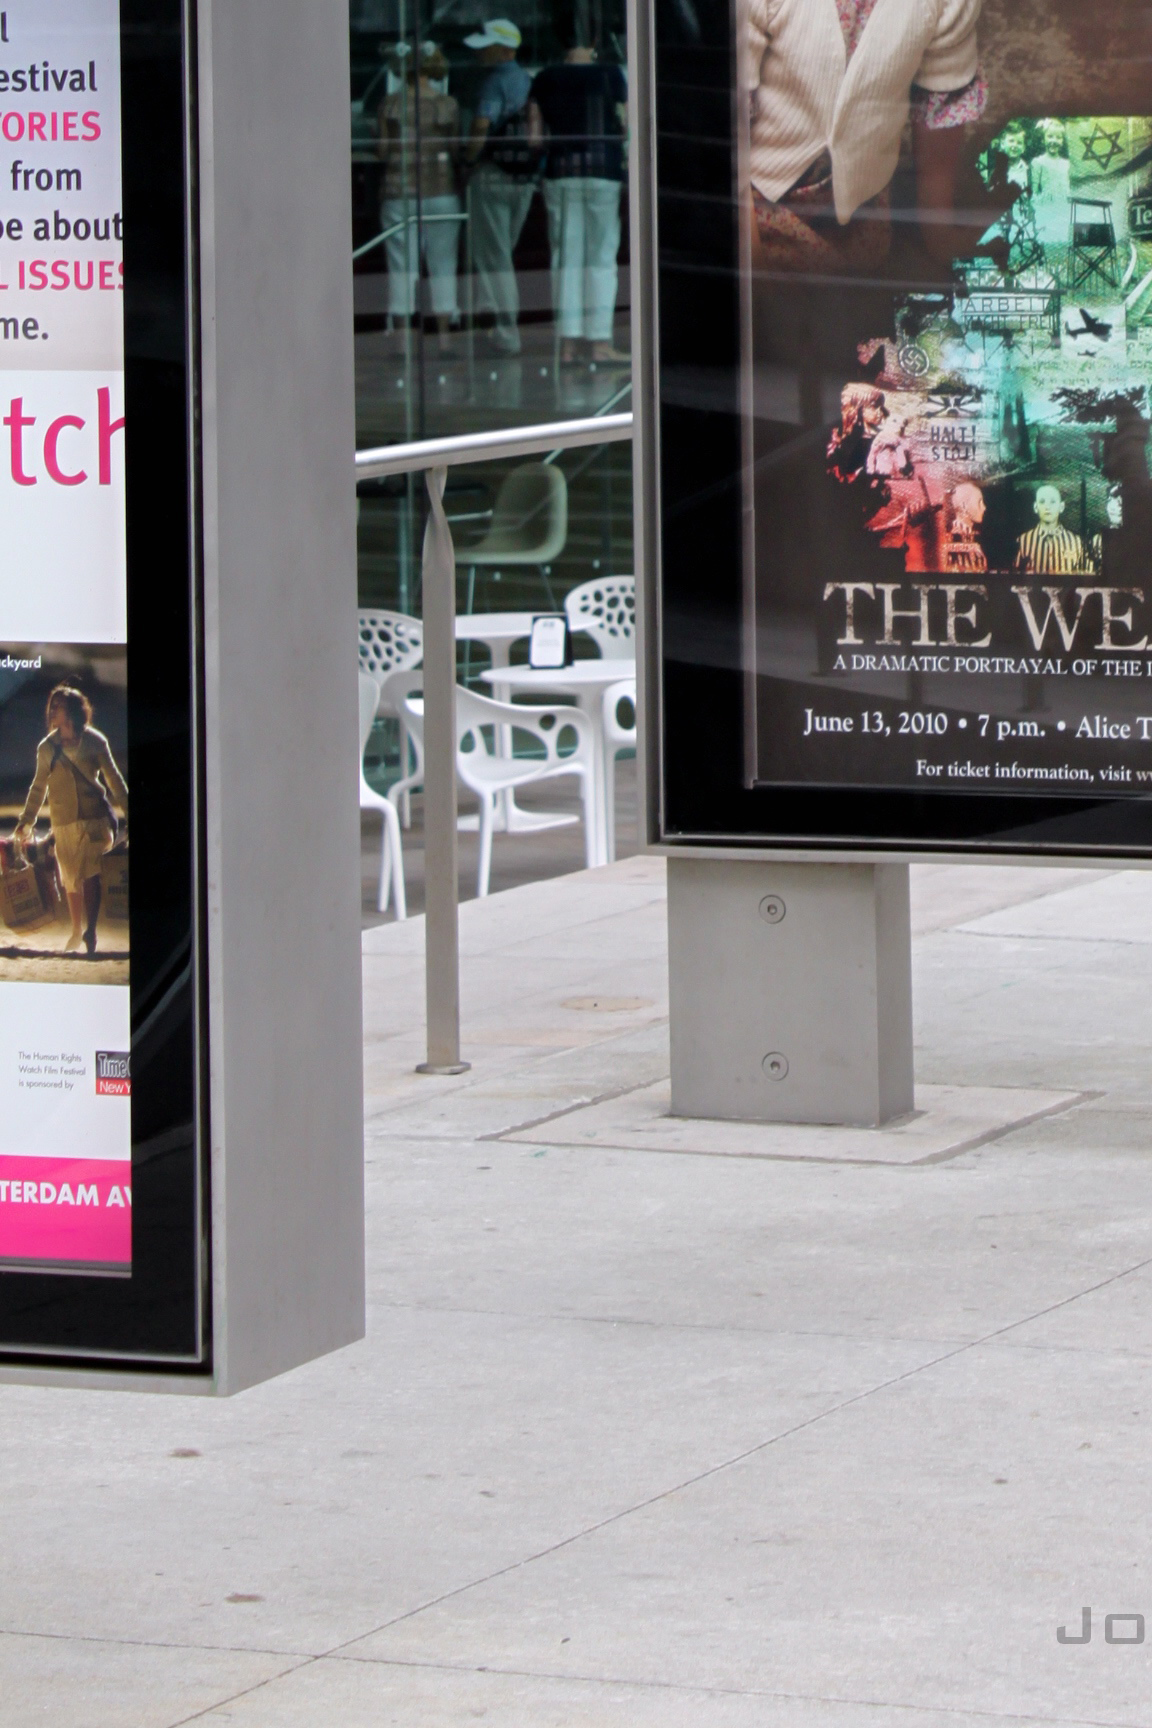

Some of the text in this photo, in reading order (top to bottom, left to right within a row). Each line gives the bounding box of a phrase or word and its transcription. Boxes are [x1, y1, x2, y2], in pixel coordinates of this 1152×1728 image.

[11, 160, 82, 191] from
[33, 210, 124, 241] about
[931, 425, 976, 443] HALT!
[823, 582, 993, 648] THE
[833, 654, 846, 671] A
[851, 654, 949, 673] DRAMATIC
[953, 657, 1067, 675] PORTRAYAL
[1071, 659, 1097, 676] OF
[1101, 660, 1142, 677] THE
[803, 711, 853, 736] June
[861, 712, 890, 742] 13,
[898, 713, 948, 737] 2010
[978, 715, 989, 738] 7
[997, 723, 1045, 745] p.m.
[1075, 717, 1131, 741] Alice
[916, 761, 943, 777] For
[947, 762, 990, 778] ticket
[994, 763, 1094, 785] information,
[1099, 765, 1132, 782] visit
[18, 1052, 82, 1063] The Human Rights
[19, 1065, 86, 1076] Watch Film Festival
[26, 1081, 62, 1091] sponsored
[64, 1082, 74, 1091] by
[100, 1082, 124, 1093] New
